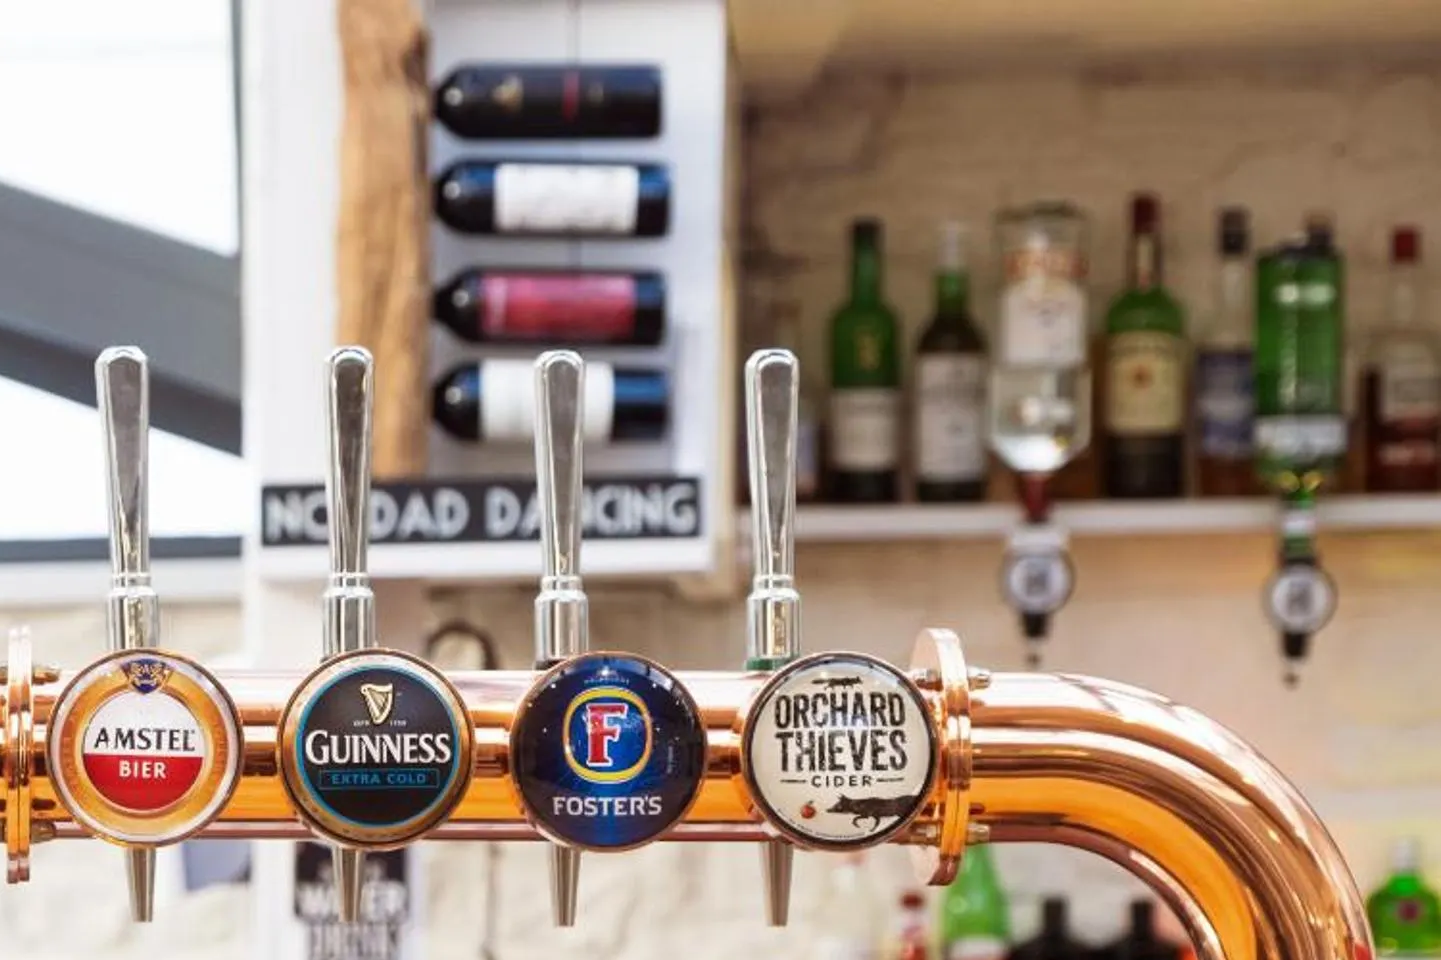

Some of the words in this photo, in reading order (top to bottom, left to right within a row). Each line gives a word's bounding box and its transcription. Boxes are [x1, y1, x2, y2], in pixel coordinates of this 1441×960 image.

[370, 487, 469, 538] DAD
[774, 691, 906, 729] ORCHARD
[94, 727, 196, 752] AMSTEL
[304, 729, 452, 765] GUINNESS
[586, 703, 629, 767] F
[775, 729, 908, 773] THIEVES
[118, 760, 167, 779] BIER
[331, 773, 381, 785] EXTRA
[386, 773, 427, 785] COLD
[810, 775, 874, 789] CIDER
[552, 796, 663, 817] FOSTER'S
